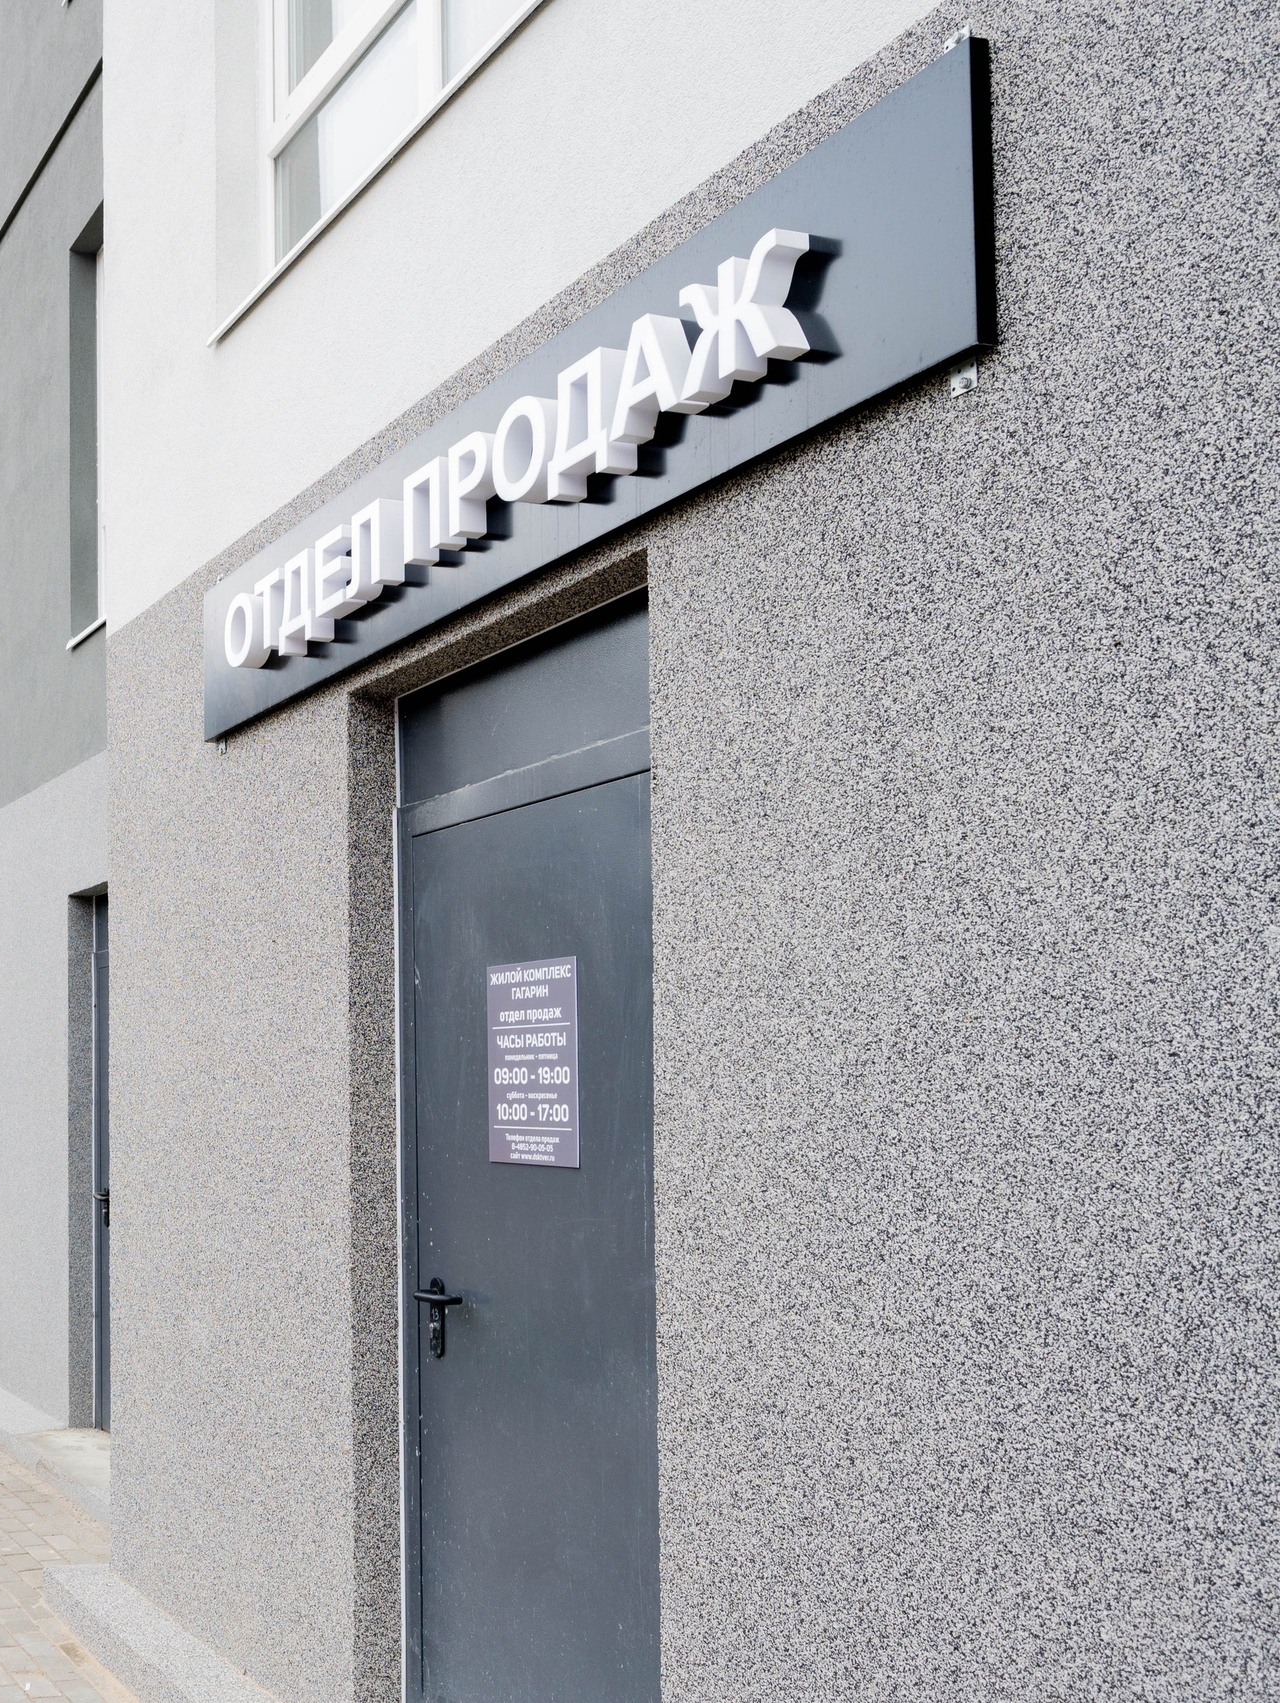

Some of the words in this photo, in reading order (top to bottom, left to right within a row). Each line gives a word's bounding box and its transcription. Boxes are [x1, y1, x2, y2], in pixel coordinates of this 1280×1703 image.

[224, 497, 404, 669] ОТДЕЛ
[403, 228, 810, 567] ПРОДАЖ
[490, 967, 522, 986] ЖИЛОЙ
[524, 965, 572, 982] КОМПЛЕКС
[511, 985, 549, 1000] ГАГАРИН
[500, 1009, 525, 1024] отдел
[526, 1006, 562, 1023] продаж
[497, 1033, 524, 1049] ЧАСЫ
[526, 1032, 566, 1048] РАБОТЫ
[494, 1067, 528, 1085] 09:00
[537, 1066, 570, 1084] 19:00
[506, 1091, 524, 1100] суббота
[496, 1104, 527, 1121] 10:00
[537, 1104, 569, 1122] 17:00
[505, 1133, 525, 1142] Телефон
